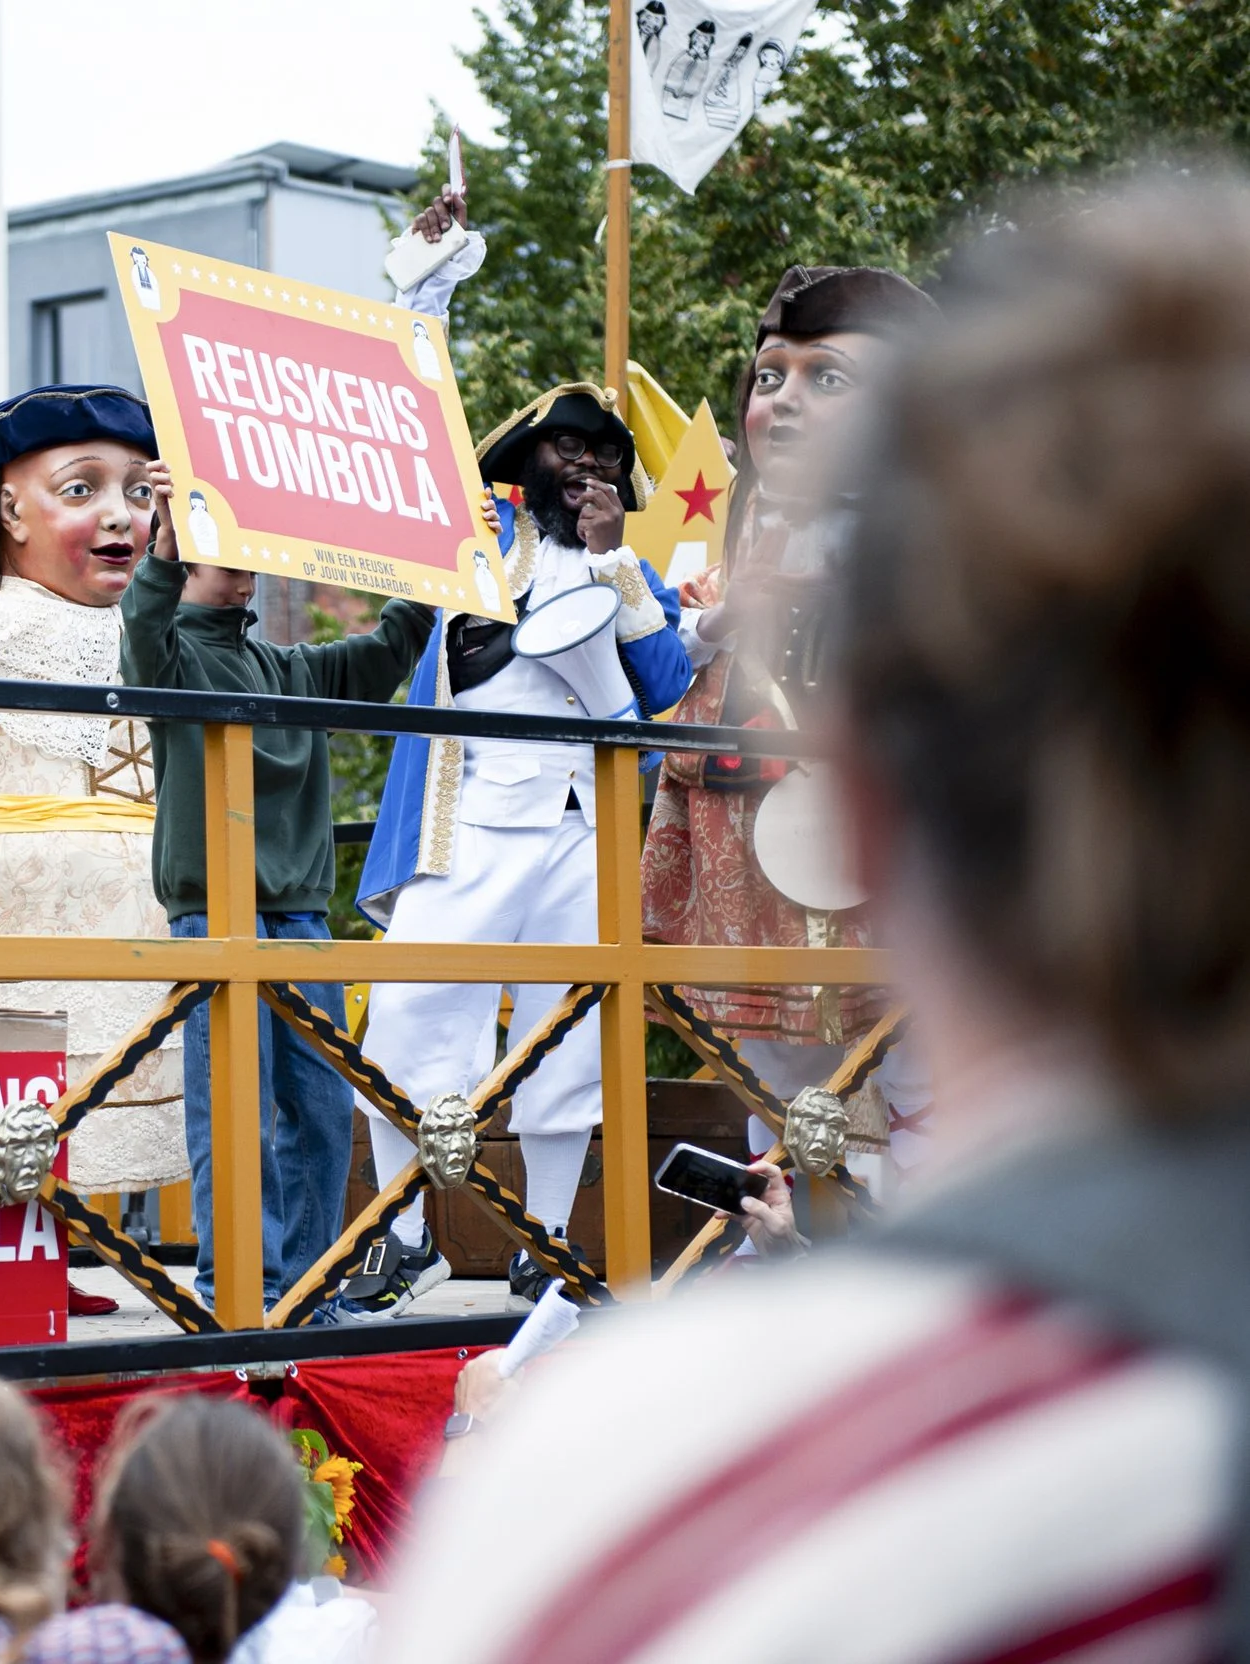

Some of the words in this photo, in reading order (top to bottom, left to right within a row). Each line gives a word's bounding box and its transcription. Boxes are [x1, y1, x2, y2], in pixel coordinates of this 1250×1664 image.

[182, 333, 429, 451] REUSKENS
[201, 406, 452, 527] TOMBOLA
[303, 562, 316, 576] OP
[320, 565, 348, 583] JOUW
[350, 571, 415, 595] VERJAARDAG!
[314, 548, 335, 564] WIN
[337, 553, 357, 568] EEN
[358, 557, 396, 577] REUSKE
